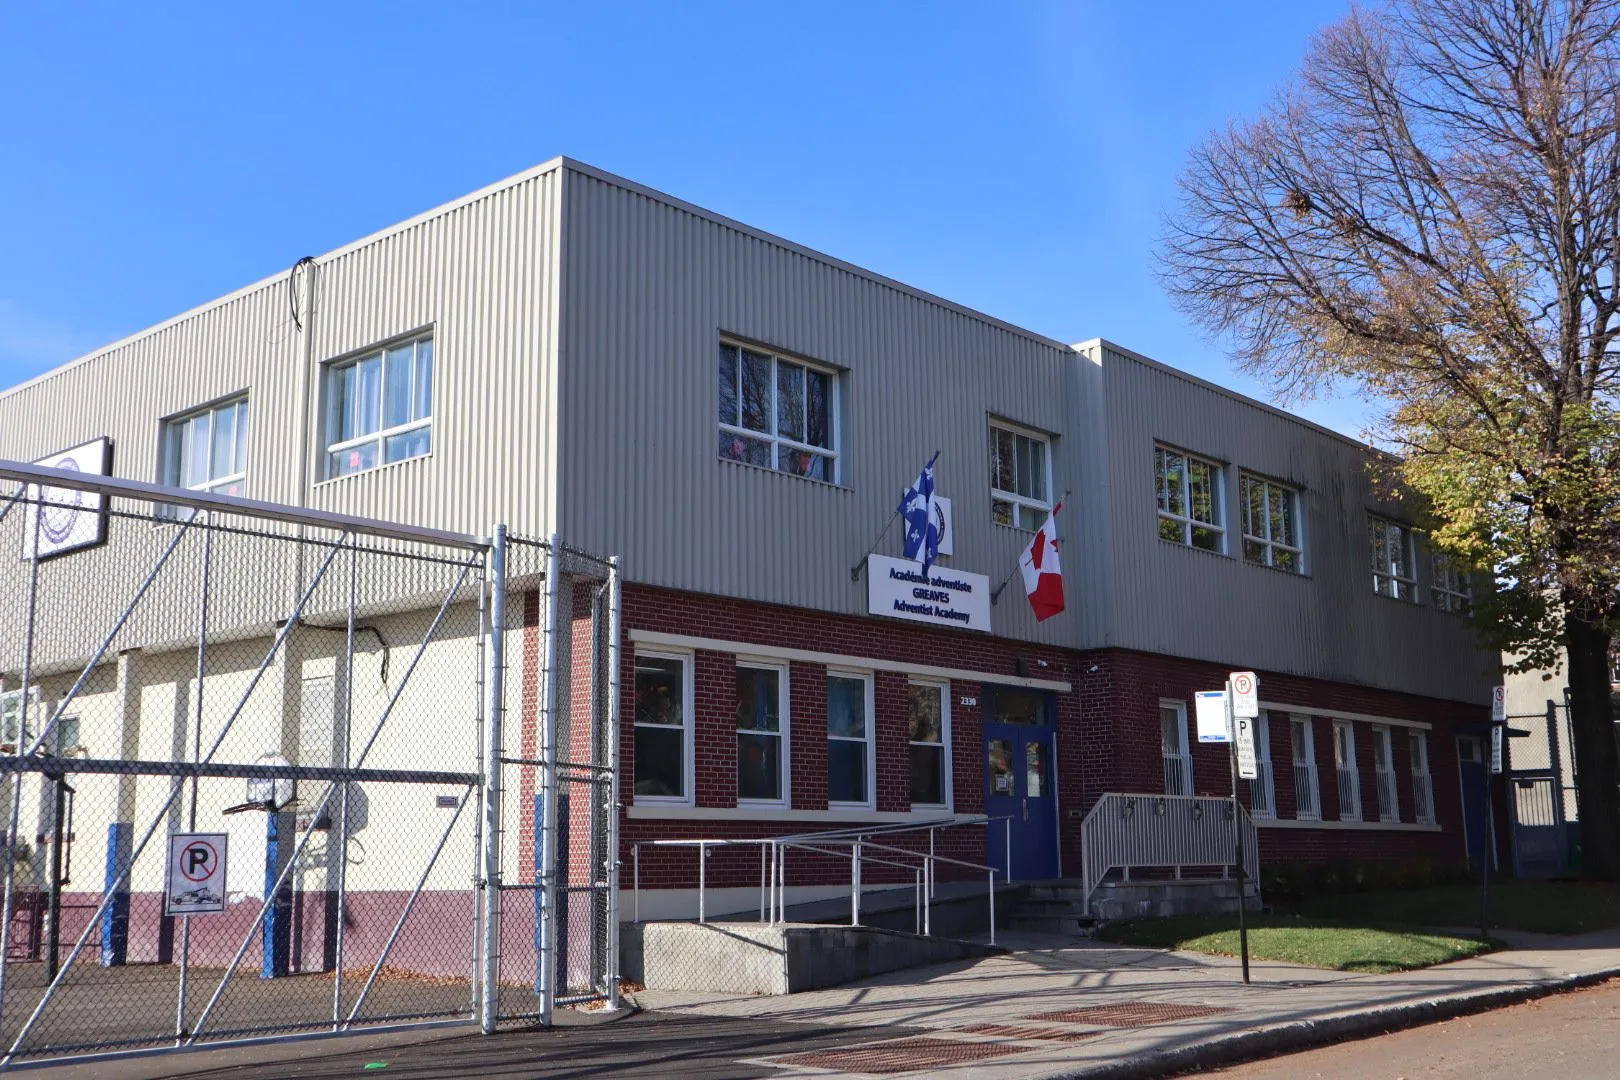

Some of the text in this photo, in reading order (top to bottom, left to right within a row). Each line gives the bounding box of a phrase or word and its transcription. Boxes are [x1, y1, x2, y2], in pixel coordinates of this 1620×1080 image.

[931, 576, 972, 593] adventiste
[912, 587, 950, 604] GREAVES
[893, 599, 970, 624] Adventist Academy
[1240, 720, 1247, 736] P
[189, 848, 209, 875] P
